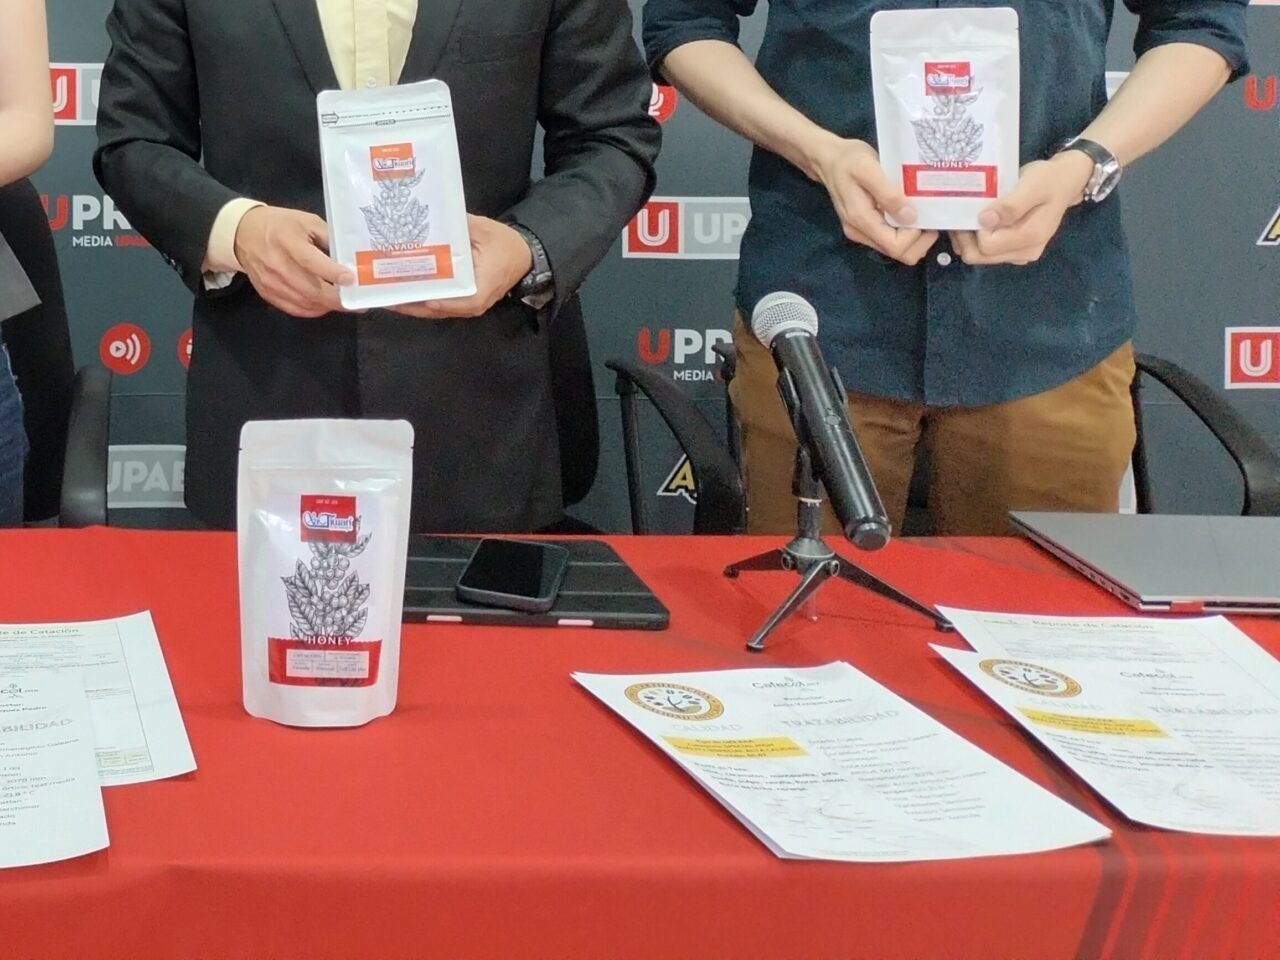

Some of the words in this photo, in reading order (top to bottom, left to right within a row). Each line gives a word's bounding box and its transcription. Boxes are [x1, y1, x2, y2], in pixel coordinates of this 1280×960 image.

[933, 160, 970, 169] HONEY
[72, 236, 112, 247] MEDIA
[381, 242, 423, 253] LAVADO
[673, 370, 714, 381] MEDIA
[29, 627, 80, 636] Catación
[307, 635, 352, 646] HONEY
